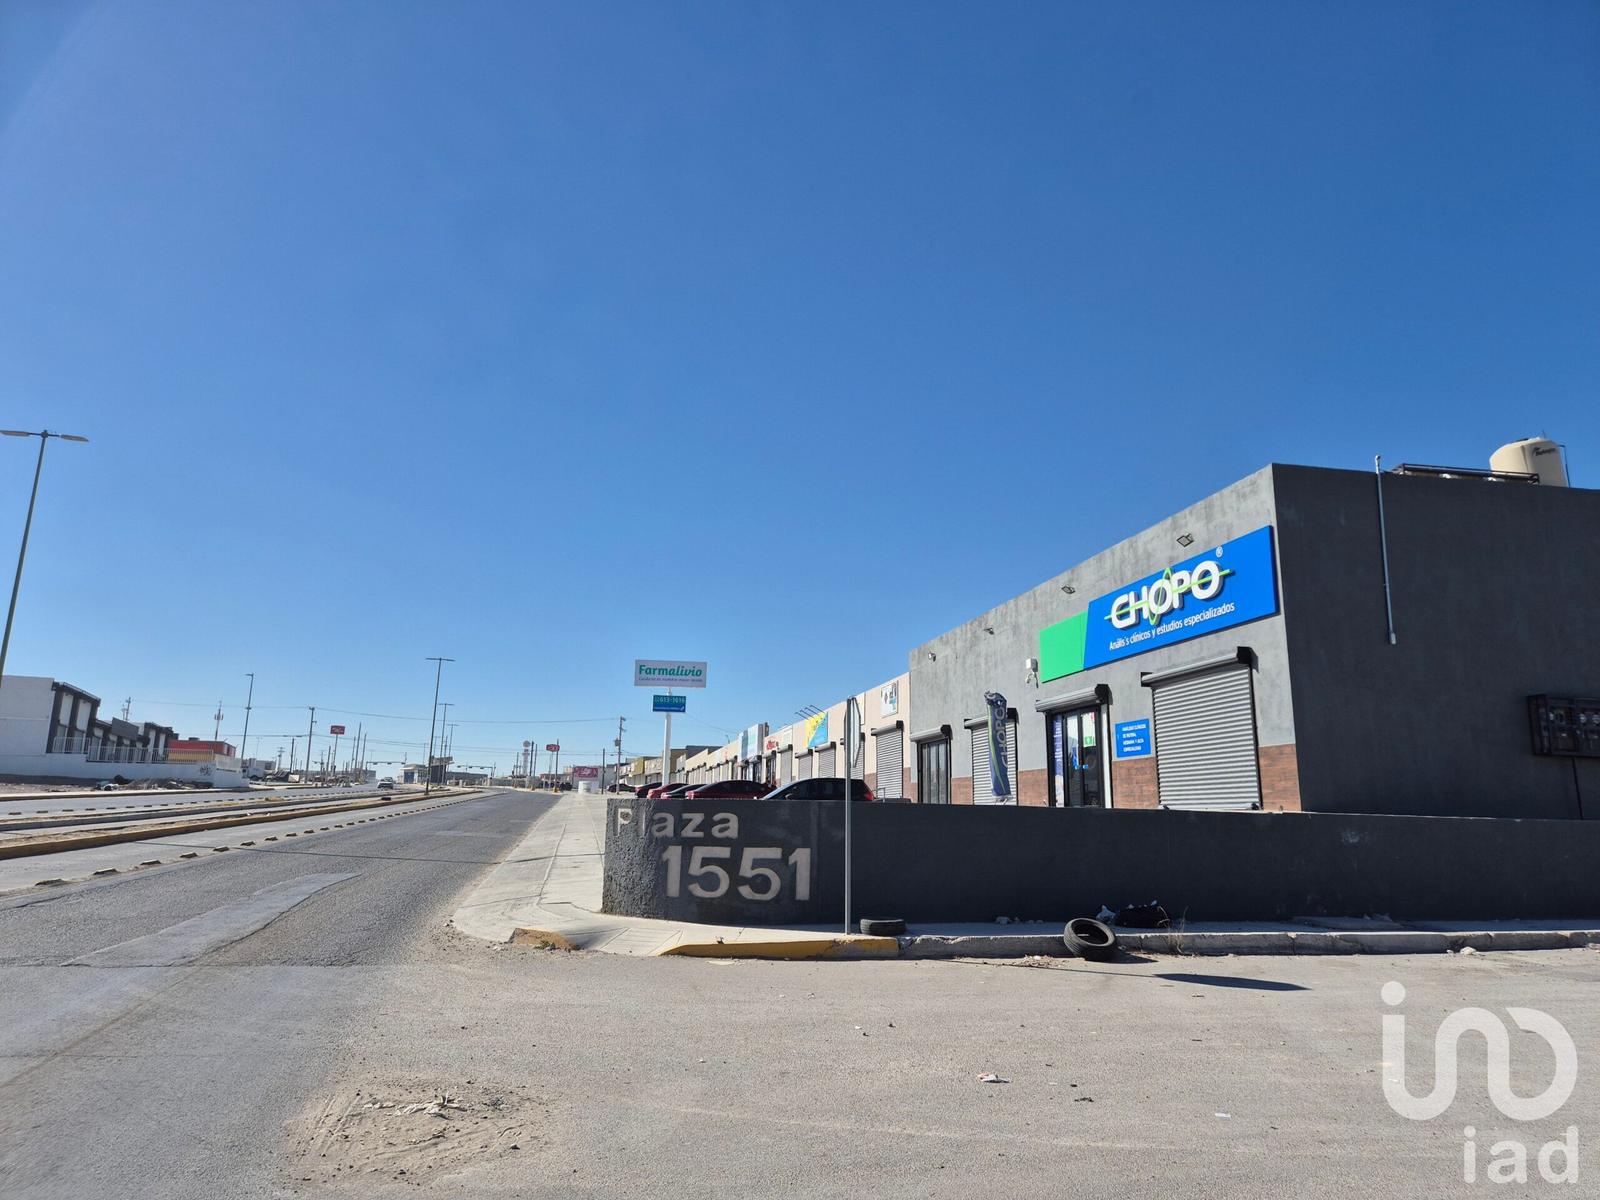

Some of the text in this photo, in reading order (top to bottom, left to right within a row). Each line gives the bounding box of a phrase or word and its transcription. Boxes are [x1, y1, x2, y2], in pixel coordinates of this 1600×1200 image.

[1110, 560, 1223, 629] CHOPO
[1109, 602, 1236, 651] Análiss clínicos y estudios especializados
[638, 664, 703, 677] Farmalivio
[661, 845, 811, 901] 1551
